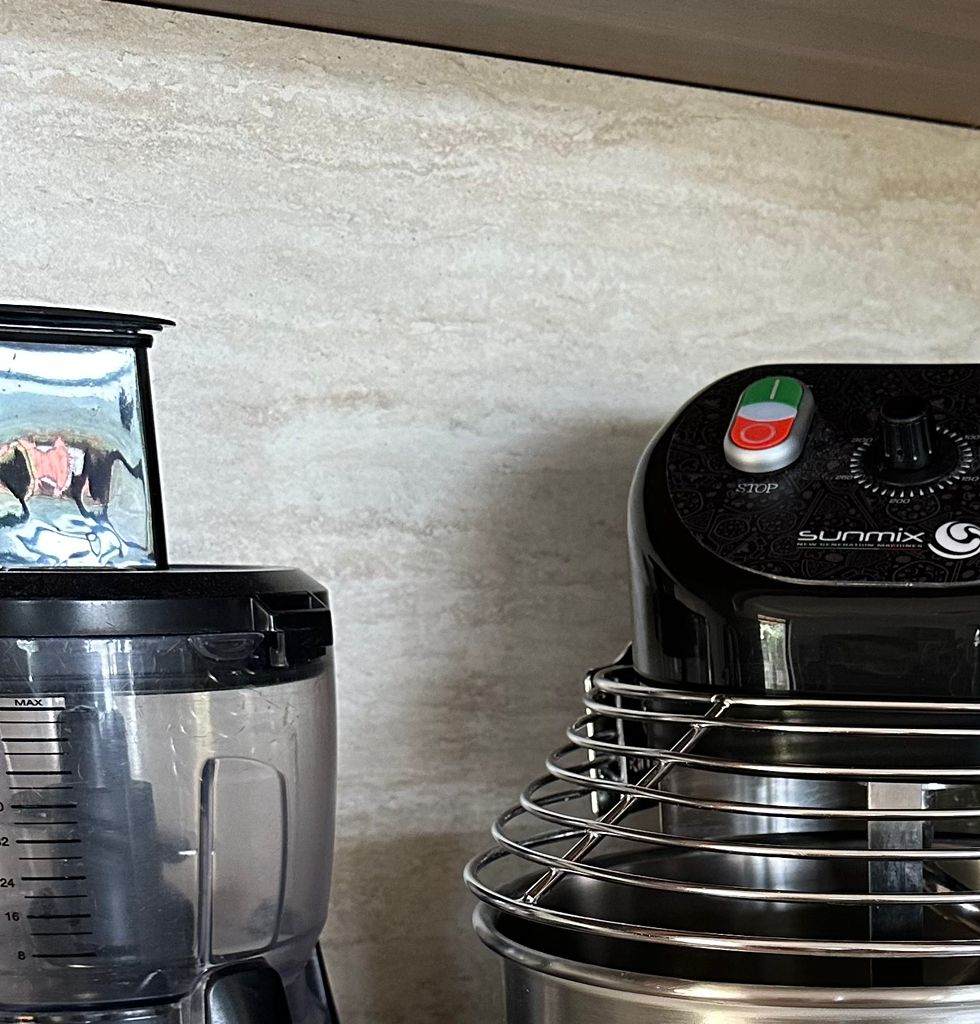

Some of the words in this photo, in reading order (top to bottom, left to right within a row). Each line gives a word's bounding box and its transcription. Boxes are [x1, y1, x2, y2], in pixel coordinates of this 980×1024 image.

[736, 483, 779, 494] STOP
[797, 528, 925, 543] sunmix
[14, 698, 43, 707] MAX
[4, 911, 20, 922] 16
[18, 950, 26, 961] 8
